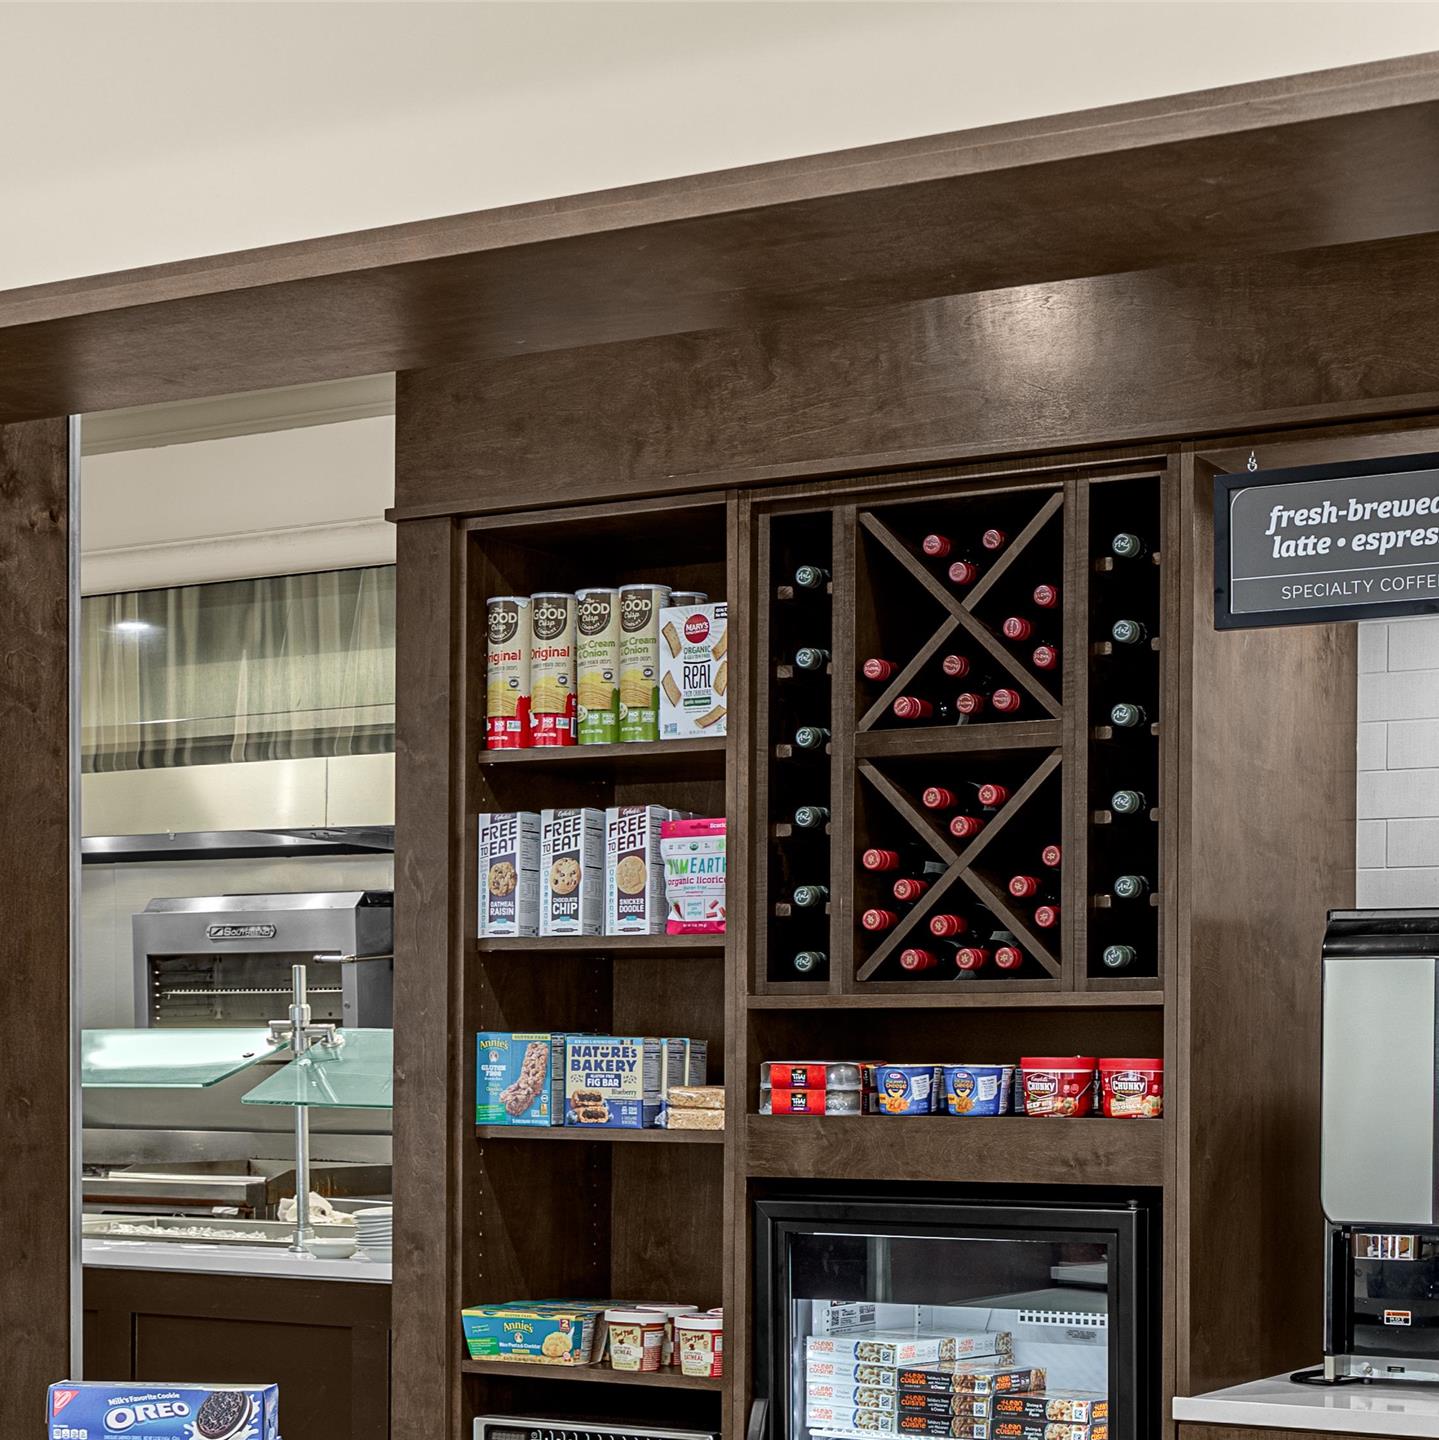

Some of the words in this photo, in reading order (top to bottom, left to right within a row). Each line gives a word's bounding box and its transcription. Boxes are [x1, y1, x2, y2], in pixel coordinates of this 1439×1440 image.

[1272, 535, 1330, 558] latte
[1281, 579, 1374, 599] SPECIALTY
[534, 609, 567, 620] GOOD
[588, 640, 615, 649] Cream
[482, 821, 517, 842] FREE
[544, 818, 581, 839] FREE
[609, 816, 646, 838] FREE
[490, 836, 517, 857] EAT
[551, 833, 580, 853] EAT
[617, 832, 646, 851] EAT
[490, 907, 514, 916] RAISIN
[553, 904, 577, 914] CHIP
[571, 1060, 636, 1071] BAKERY
[587, 1079, 601, 1087] FIG
[603, 1079, 619, 1087] BAR
[108, 1396, 129, 1406] Milk's
[129, 1393, 157, 1402] Favorite
[104, 1402, 190, 1430] OREO
